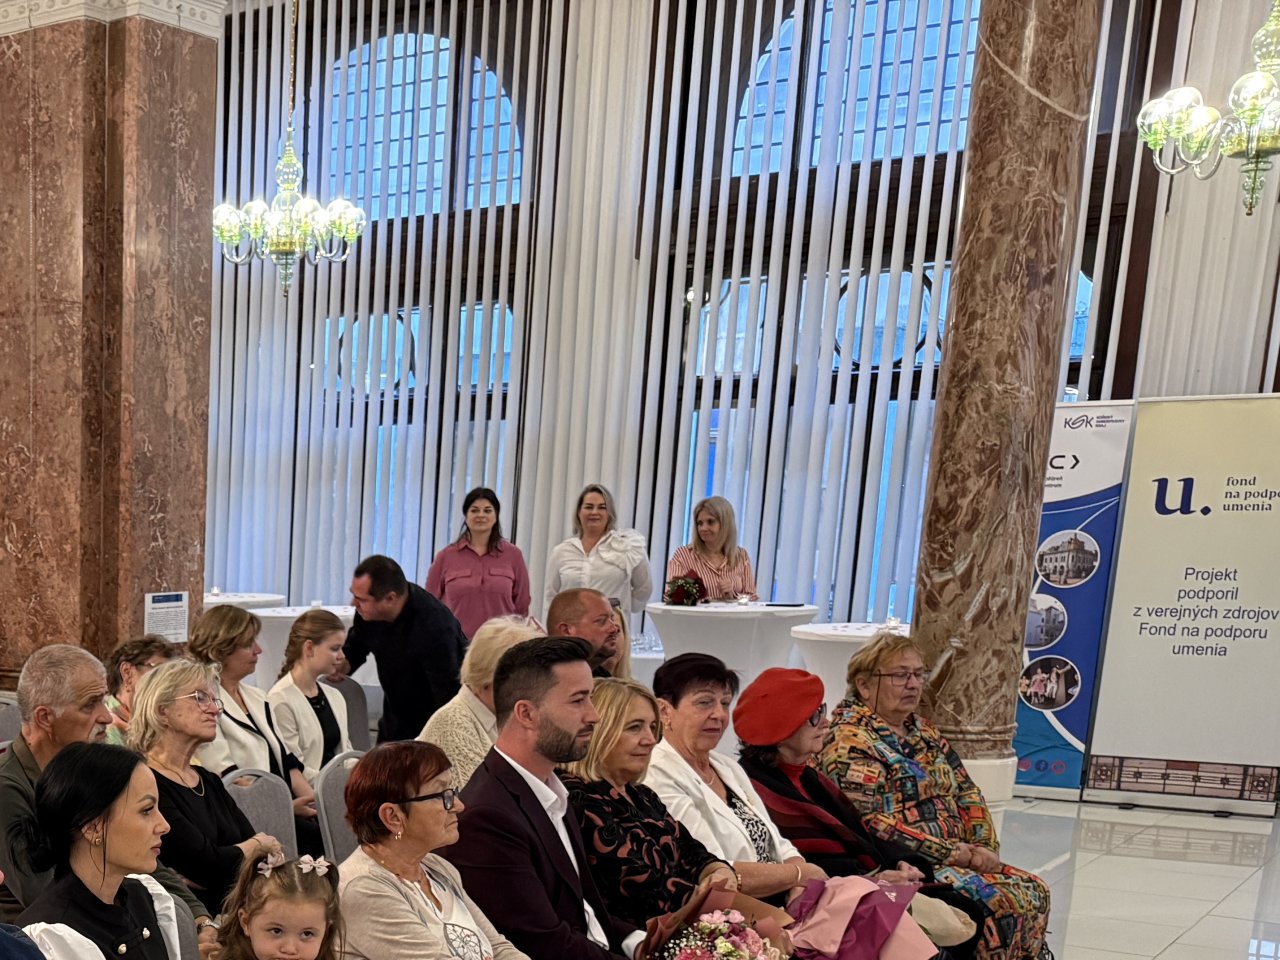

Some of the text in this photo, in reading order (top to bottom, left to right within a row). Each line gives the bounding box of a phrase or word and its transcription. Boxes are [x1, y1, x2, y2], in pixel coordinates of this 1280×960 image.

[1226, 476, 1257, 487] fond
[1224, 490, 1240, 499] na
[1222, 501, 1272, 512] umenia
[1184, 567, 1238, 585] Projekt
[1177, 586, 1239, 602] podporil
[1133, 604, 1280, 623] z verejných zdrojov
[1138, 622, 1268, 641] Fond na podporu
[1172, 643, 1228, 657] umenia
